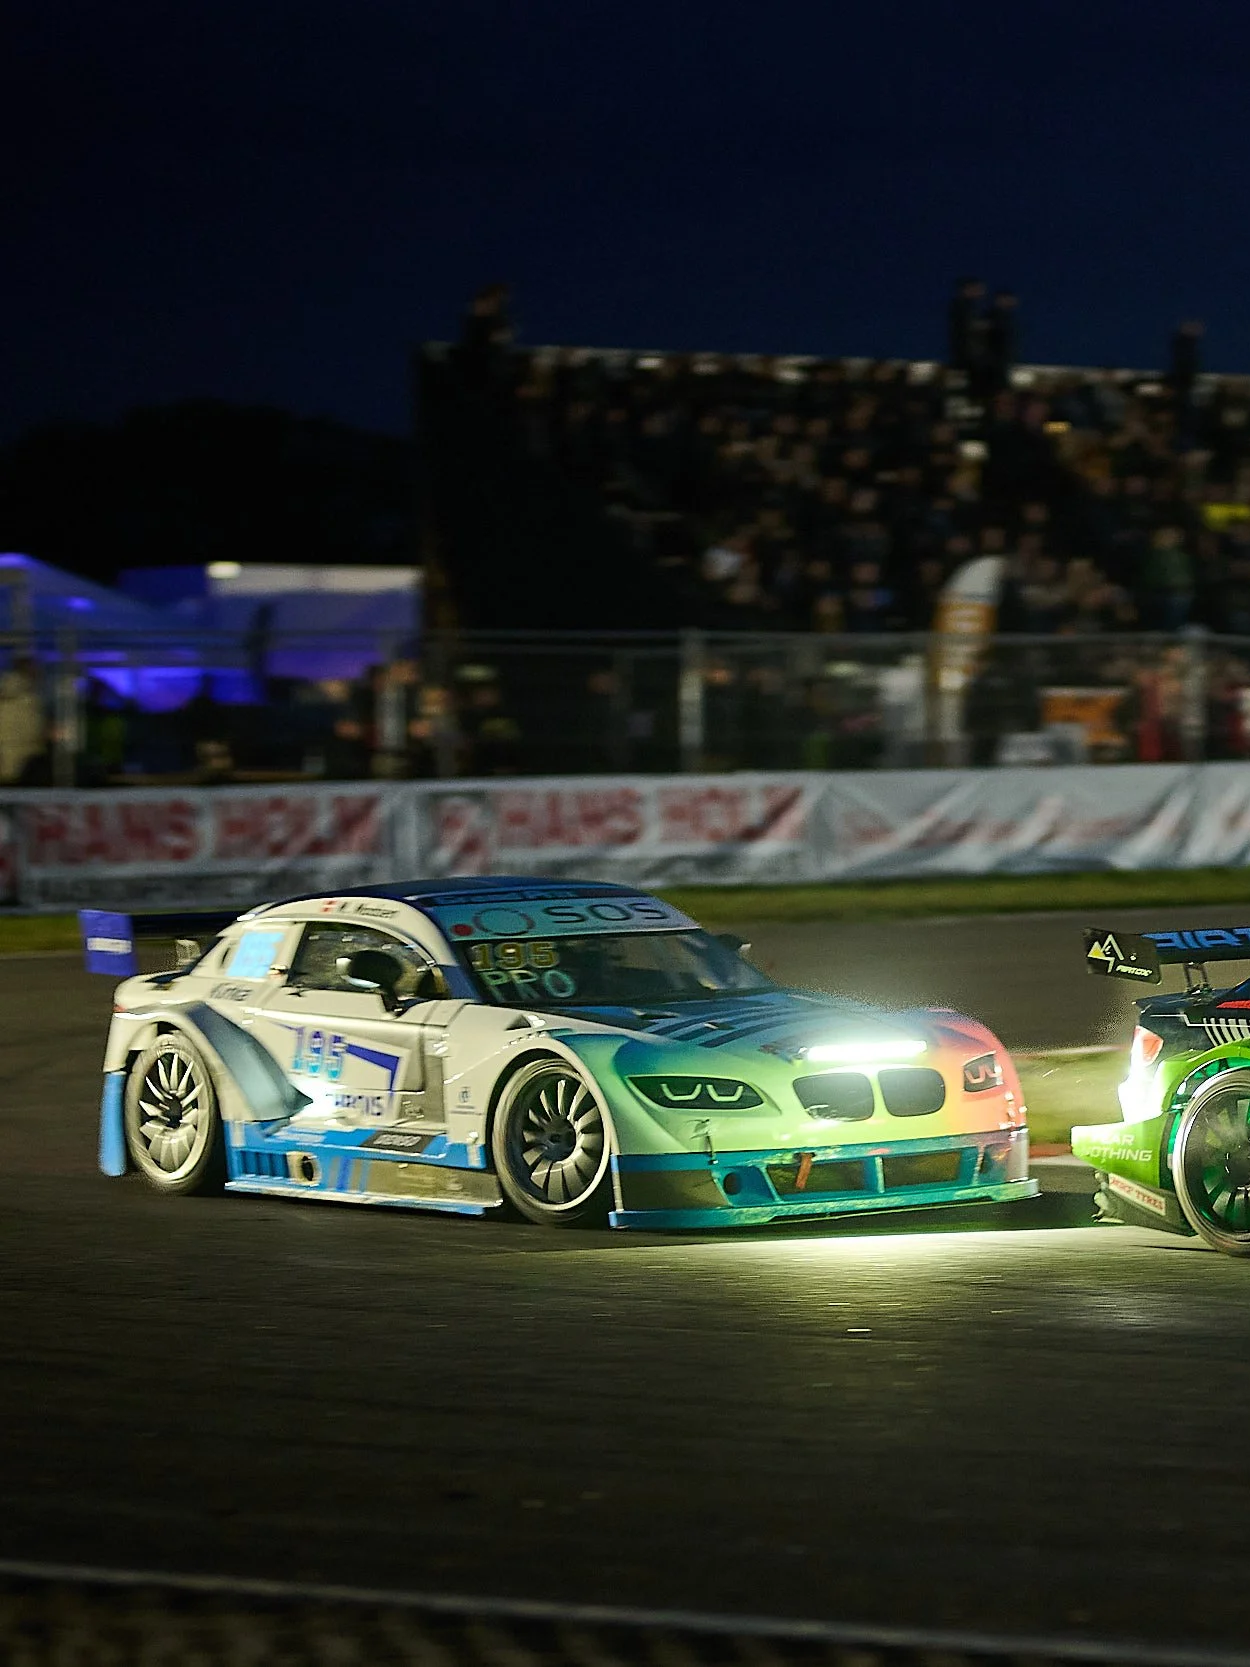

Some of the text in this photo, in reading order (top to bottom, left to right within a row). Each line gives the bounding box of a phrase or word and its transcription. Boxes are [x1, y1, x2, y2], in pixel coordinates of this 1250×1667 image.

[544, 902, 670, 924] SOS
[471, 941, 560, 971] 195
[479, 969, 577, 1001] PRO
